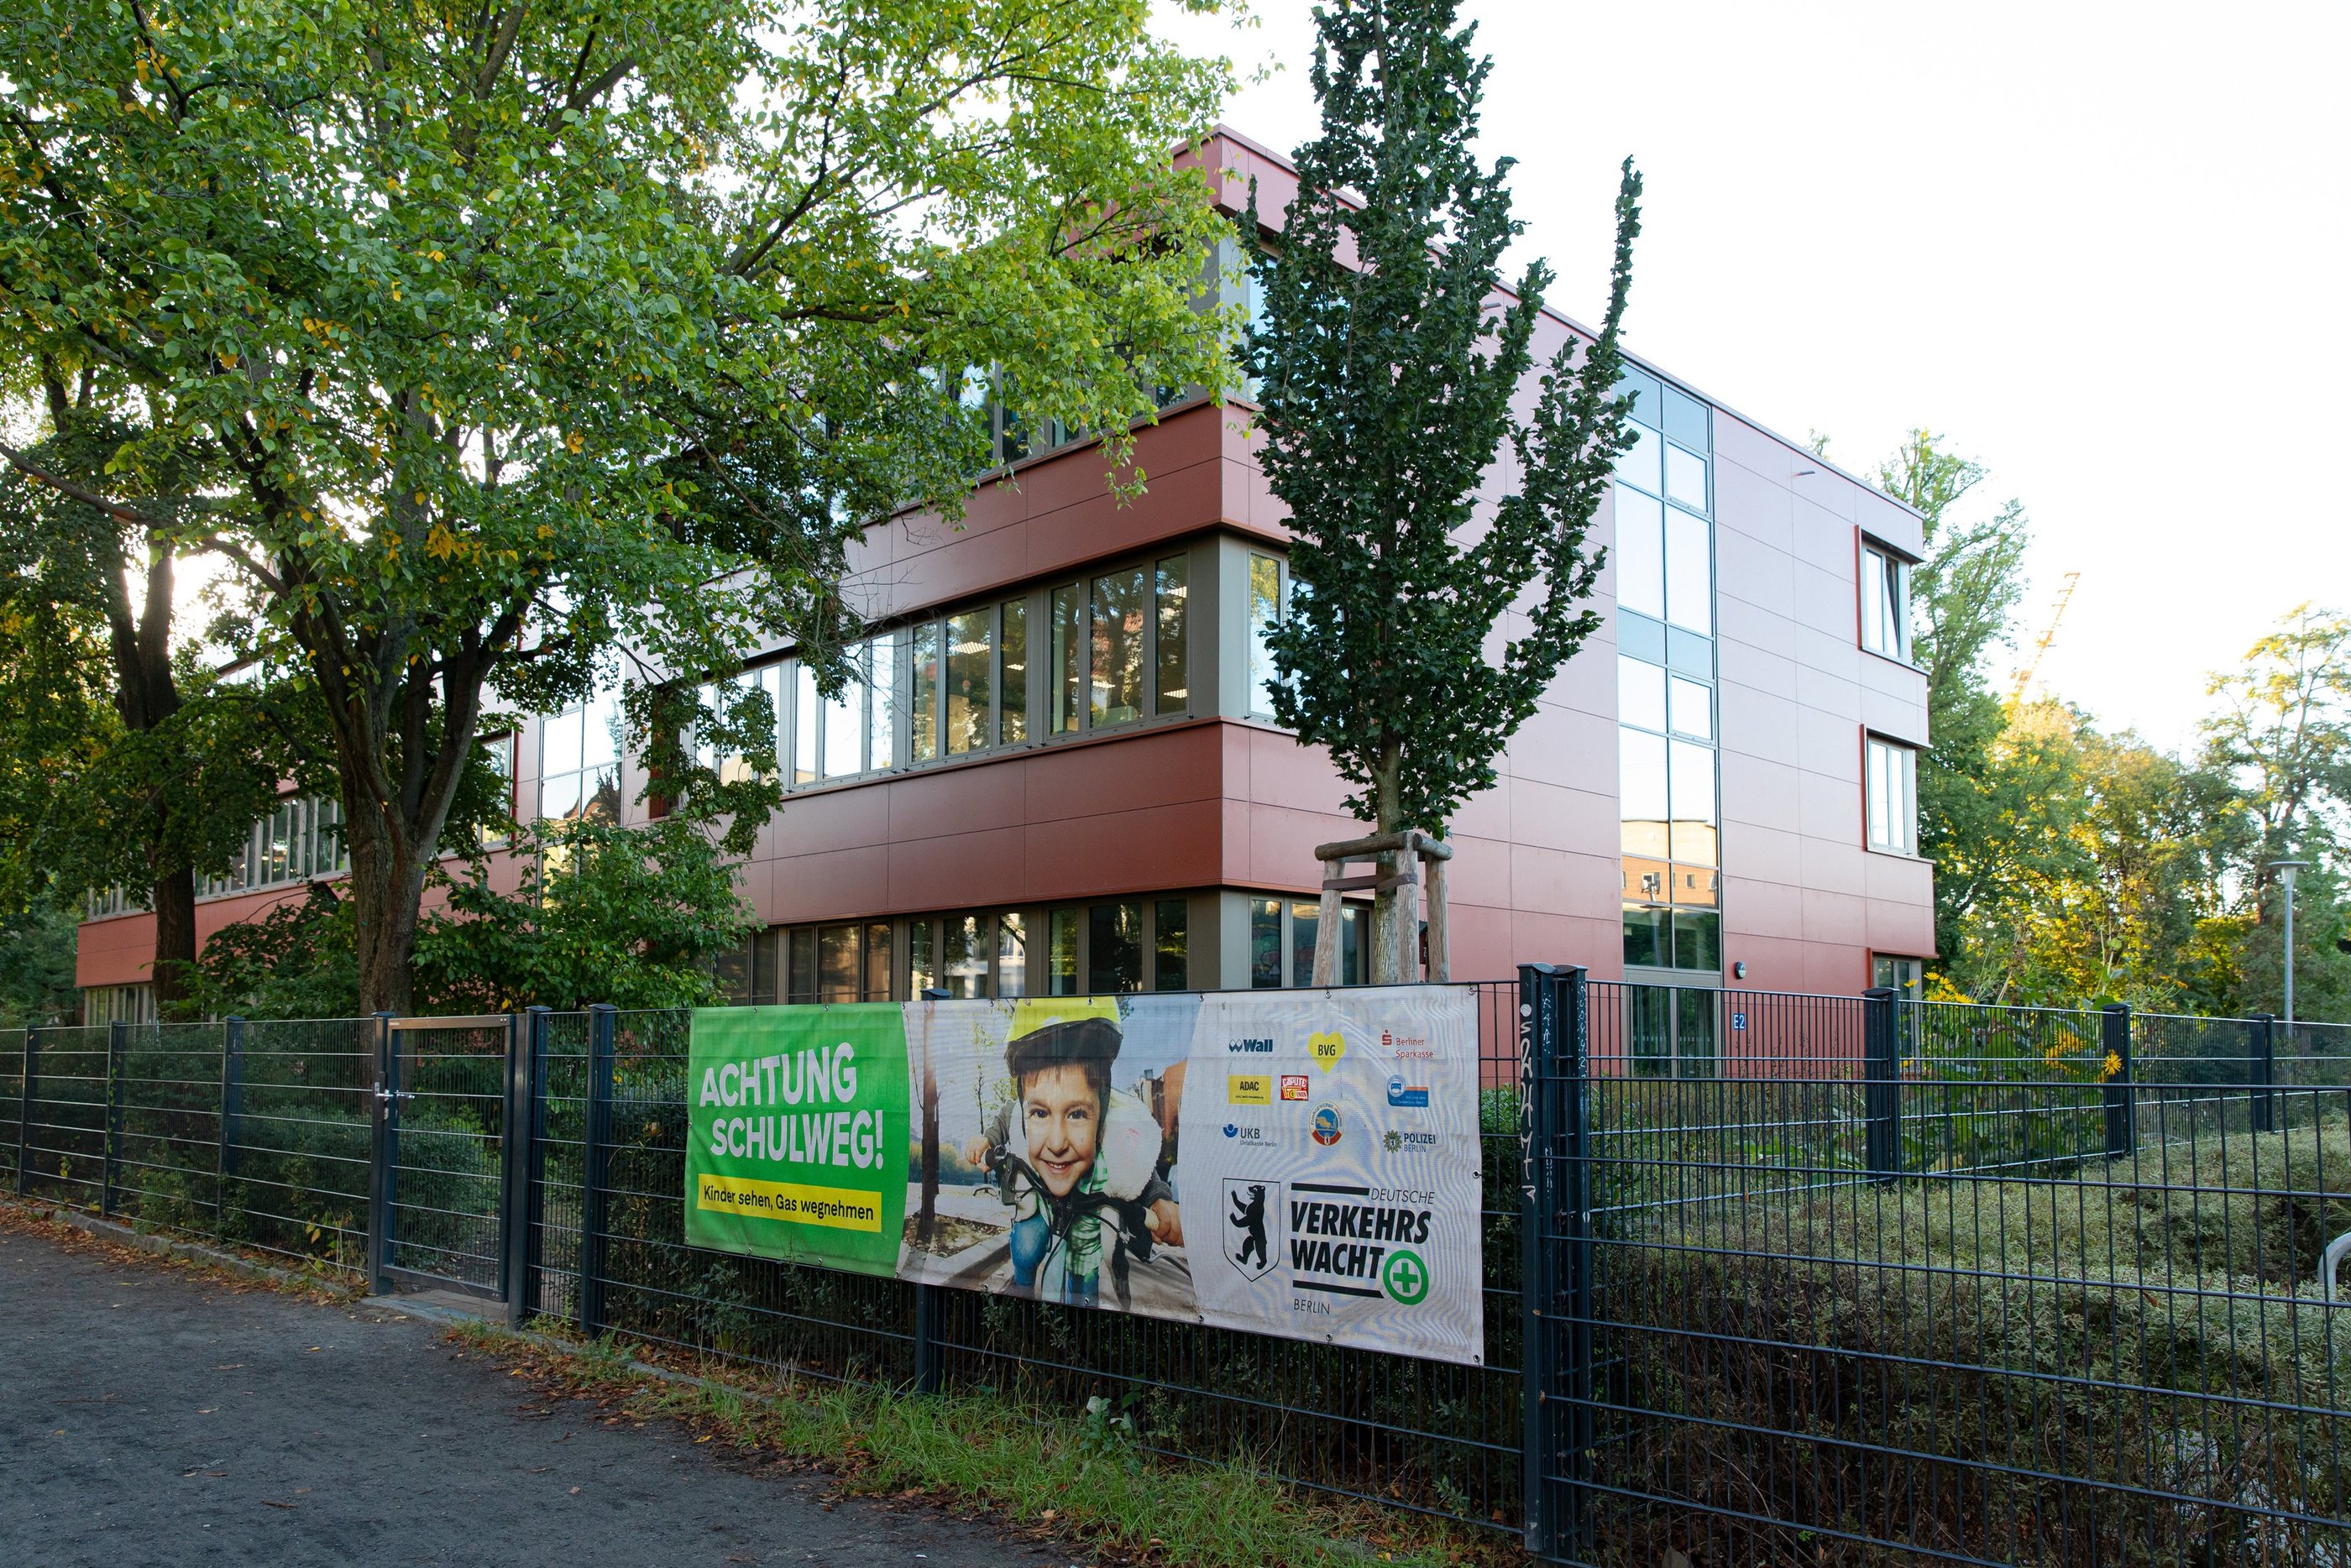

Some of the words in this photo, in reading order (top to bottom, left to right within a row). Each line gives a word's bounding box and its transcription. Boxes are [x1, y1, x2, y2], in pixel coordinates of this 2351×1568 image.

[1734, 1014, 1745, 1029] E2
[1244, 1038, 1274, 1053] Wall
[1396, 1037, 1425, 1046] Berliner
[1317, 1044, 1336, 1056] BVG
[1395, 1049, 1434, 1059] Sparkasse
[699, 1042, 857, 1107] ACHTUNG
[1239, 1081, 1259, 1091] ADAC
[710, 1109, 884, 1170] SCHULWEG!
[1240, 1127, 1260, 1139] UKB
[1404, 1132, 1436, 1144] POLIZEI
[1404, 1143, 1427, 1152] BERLIN
[704, 1185, 736, 1203] Kinder
[738, 1190, 773, 1211] sehen,
[775, 1194, 798, 1211] Gas
[800, 1200, 874, 1220] wegnehmen
[1370, 1187, 1436, 1205] DEUTSCHE
[1291, 1200, 1432, 1245] VERKEHRS
[1291, 1238, 1385, 1279] WACHT
[1293, 1298, 1331, 1315] BERLIN
